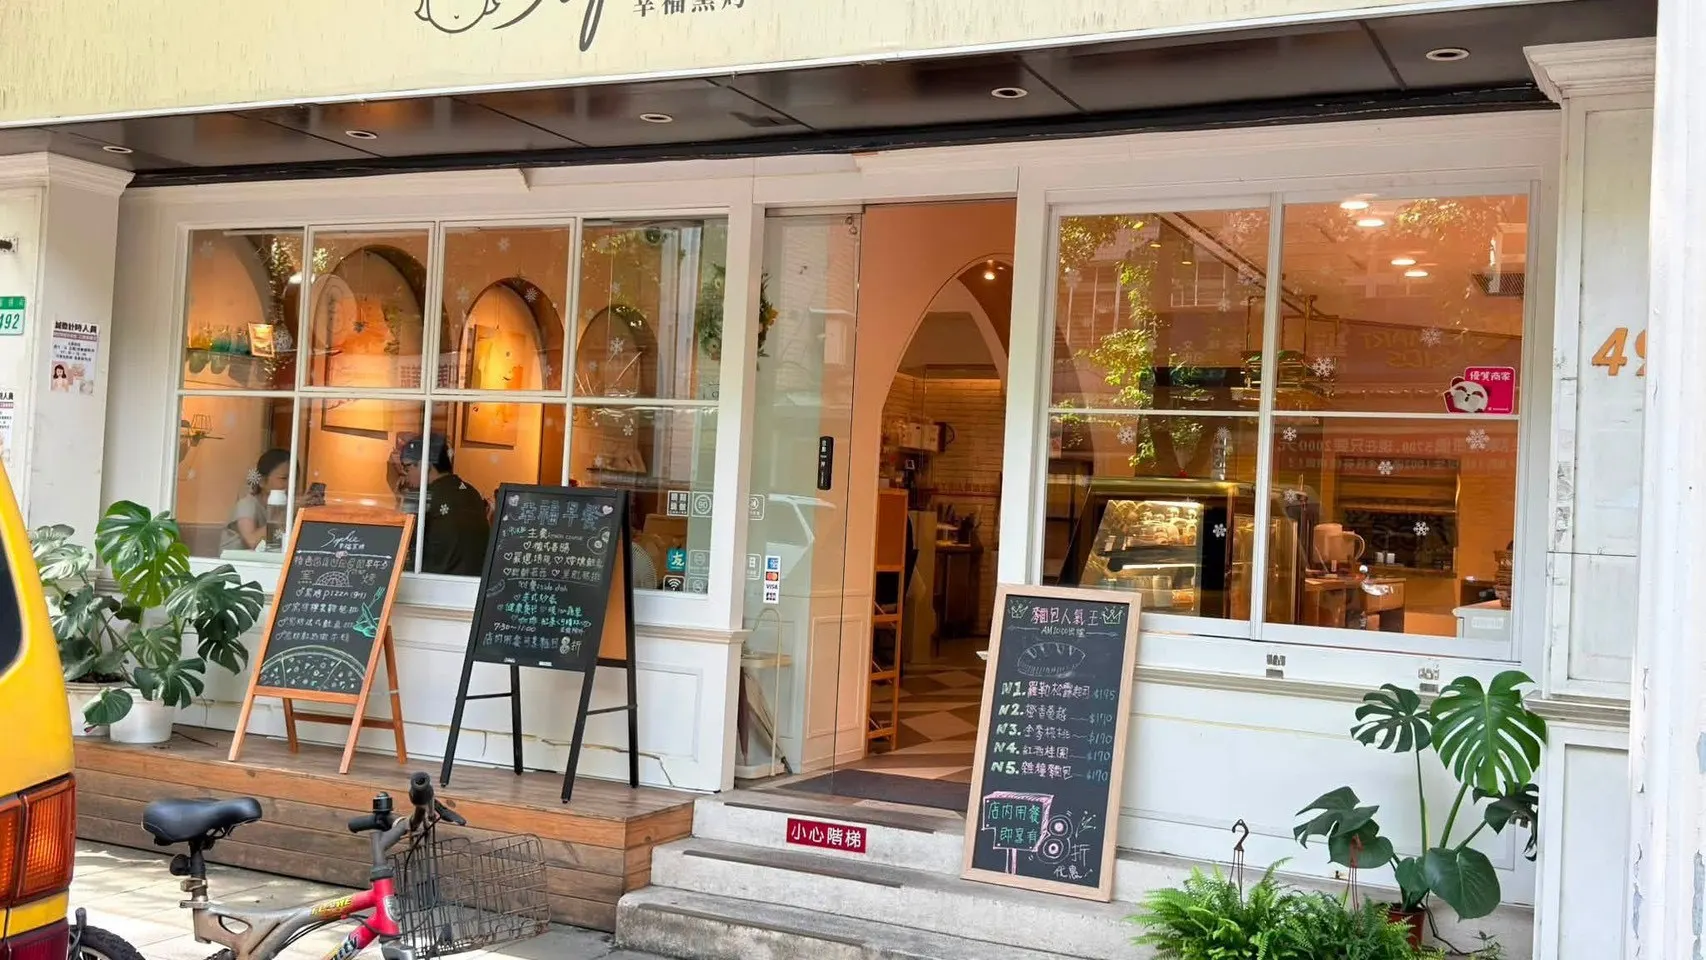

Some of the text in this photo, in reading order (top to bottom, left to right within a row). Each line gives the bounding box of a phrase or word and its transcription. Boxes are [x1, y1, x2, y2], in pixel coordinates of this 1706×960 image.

[1470, 370, 1512, 381] 優質商家
[519, 500, 604, 530] 幸福早餐
[1030, 606, 1099, 626] 麵包人氣王
[987, 801, 1041, 825] 店內用餐
[790, 822, 862, 849] 小心階梯
[1000, 826, 1039, 844] 即享有
